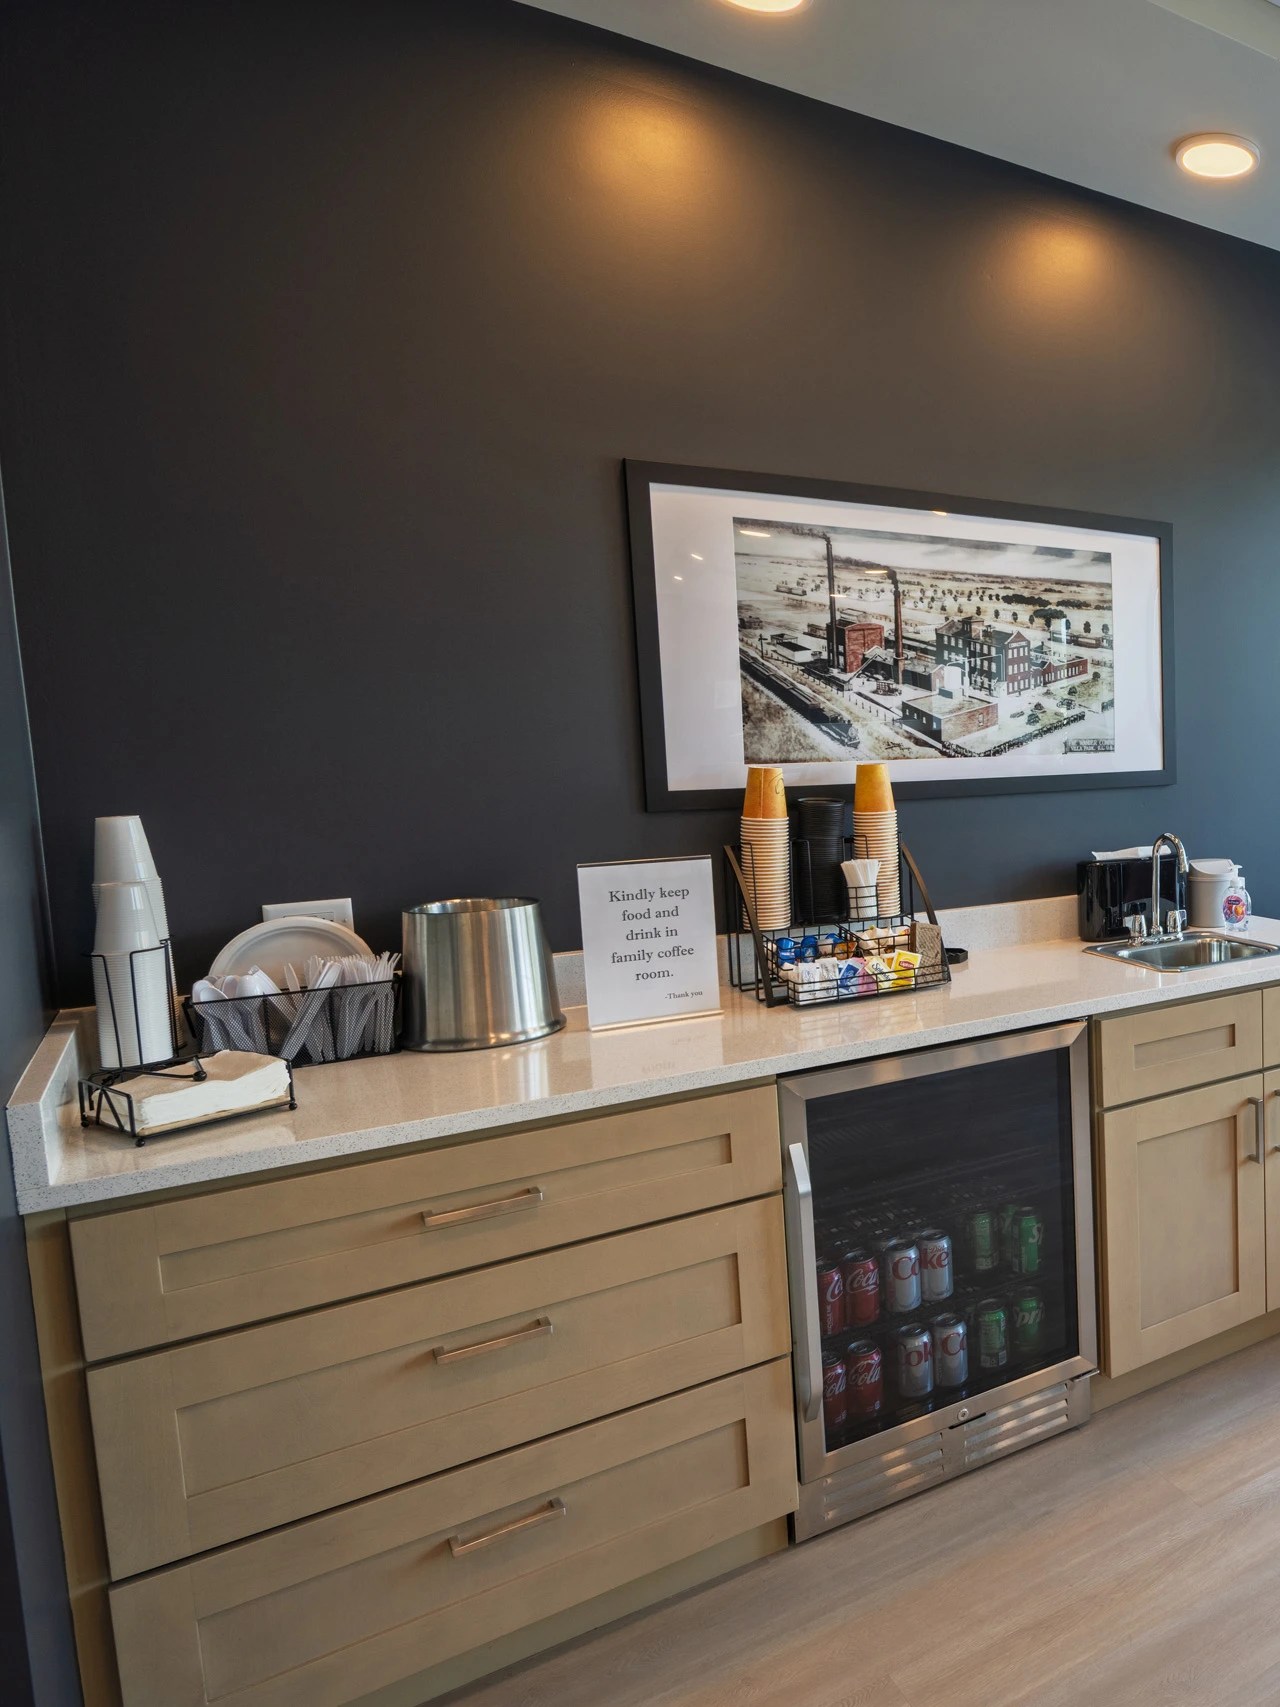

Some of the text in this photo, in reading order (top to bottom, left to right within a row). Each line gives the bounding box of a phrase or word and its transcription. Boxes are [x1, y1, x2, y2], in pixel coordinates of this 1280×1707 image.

[608, 887, 690, 903] Kindly keep
[621, 905, 680, 922] food and
[625, 926, 678, 941] drink in
[611, 945, 695, 964] family coffee
[635, 968, 674, 981] room.
[690, 989, 704, 999] you
